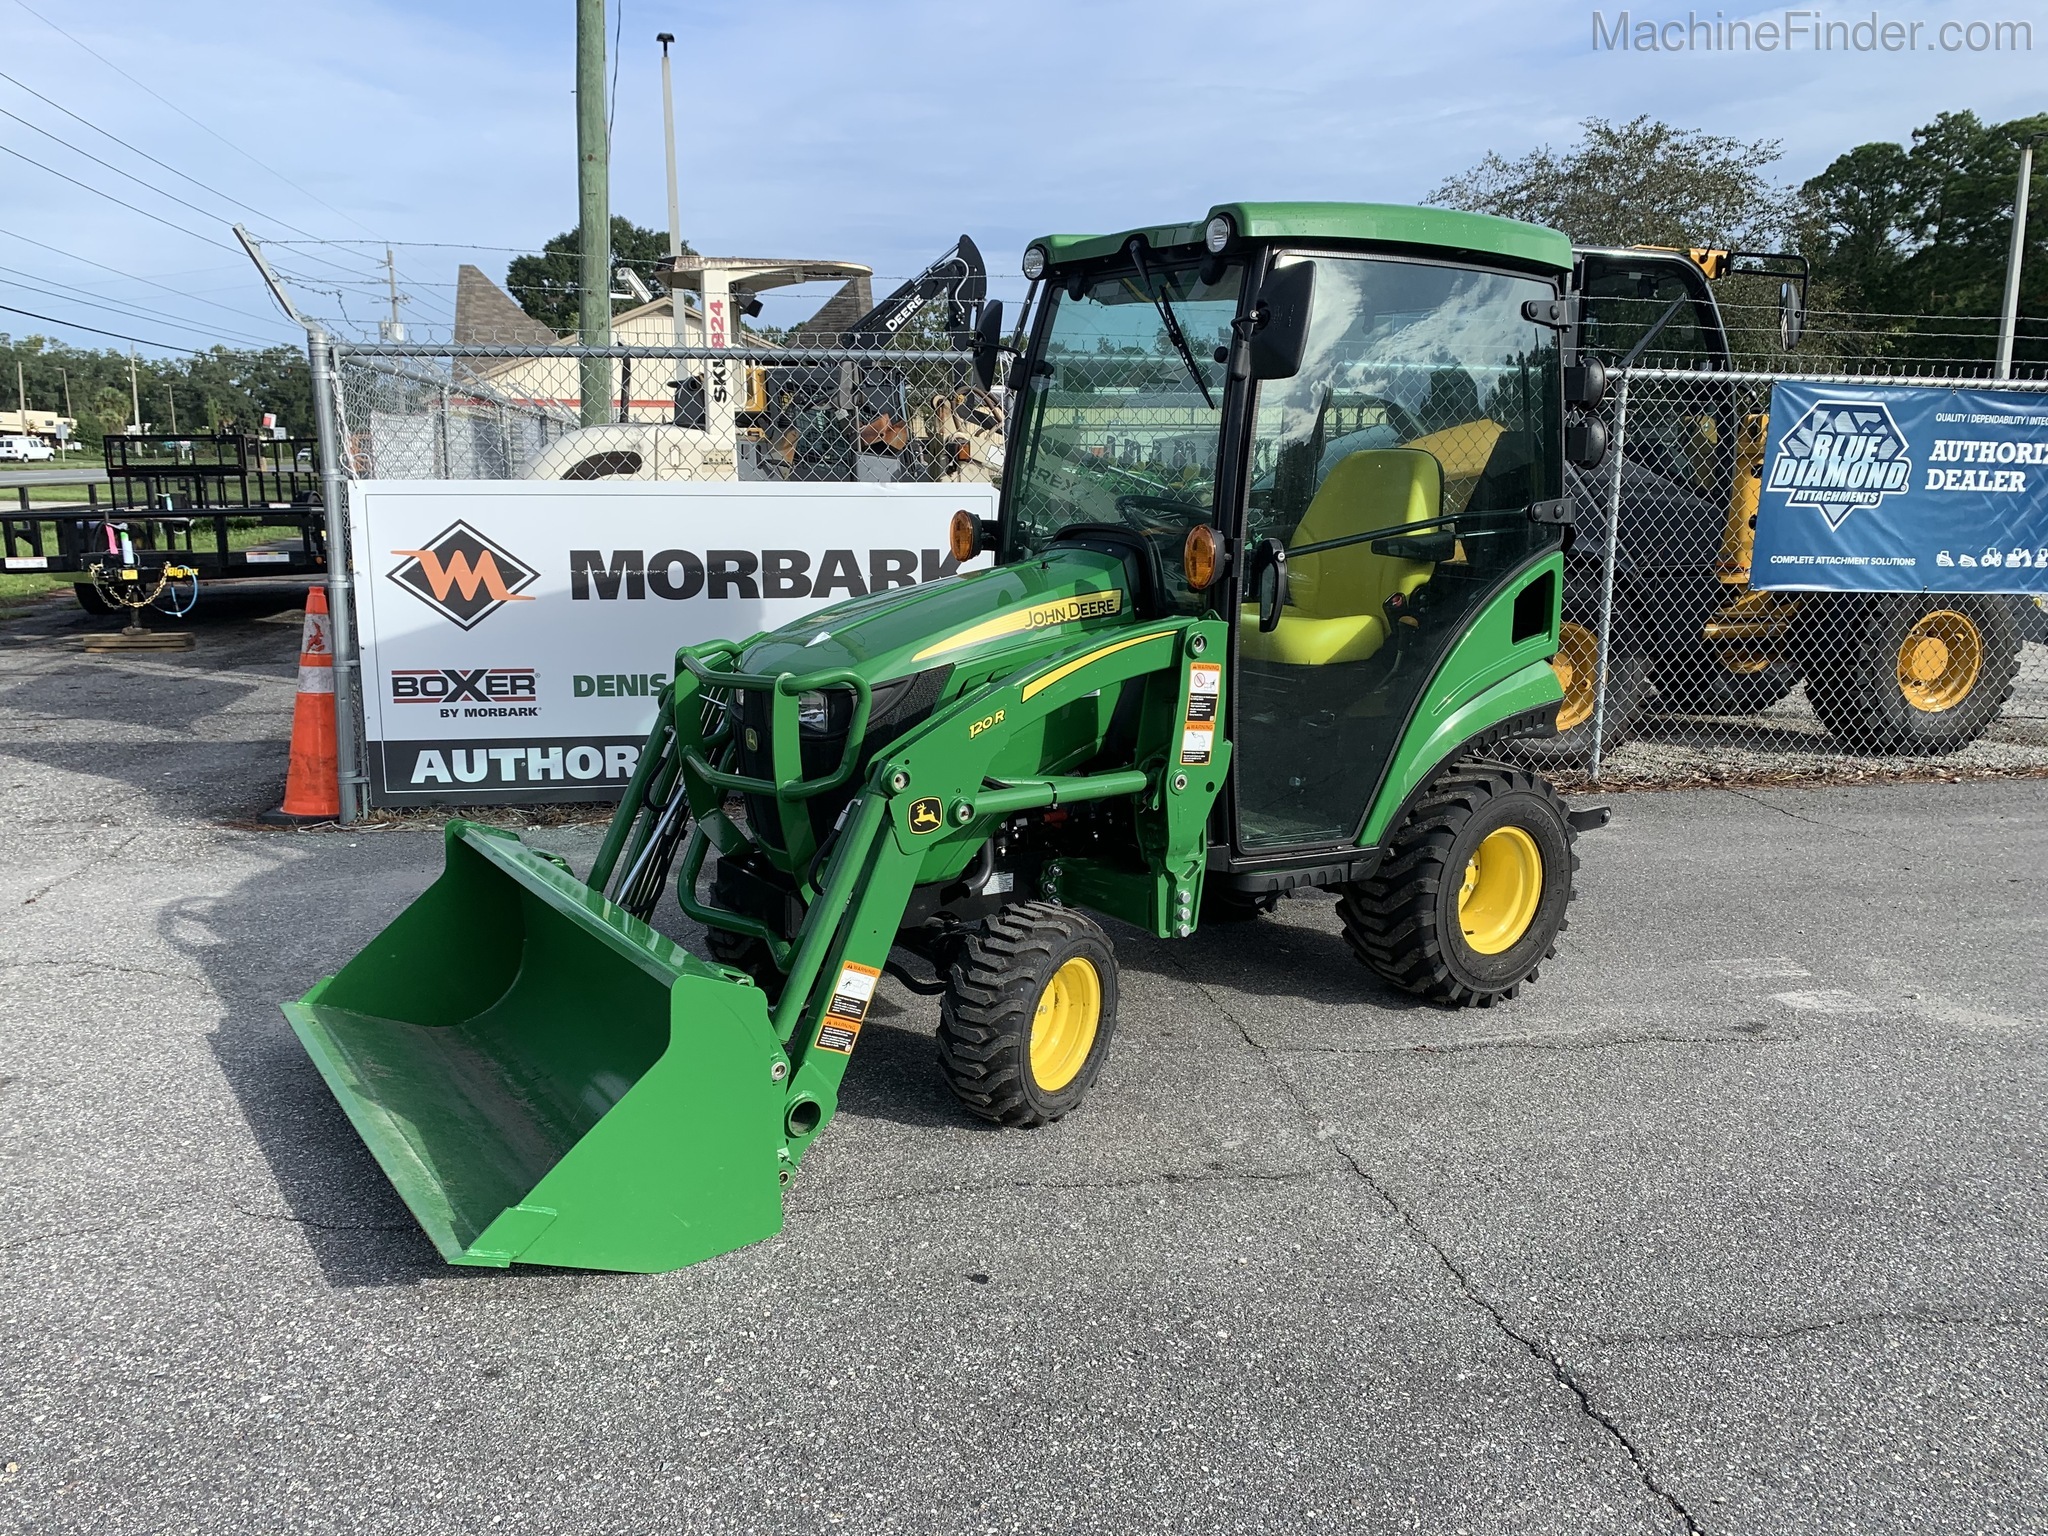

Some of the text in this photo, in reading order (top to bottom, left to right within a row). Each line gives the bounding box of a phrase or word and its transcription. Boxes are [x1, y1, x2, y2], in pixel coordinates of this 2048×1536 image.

[710, 300, 725, 349] 824
[885, 294, 924, 332] DEERE
[1935, 413, 1967, 422] QUALITY
[1971, 414, 2026, 425] DEPENDABILITY
[1809, 434, 1882, 463] BLUE
[1773, 458, 1907, 489] DIAMOND
[1924, 468, 2026, 492] DEALER
[1794, 490, 1879, 503] ATTACHMENTS
[1770, 555, 1916, 566] COMPLETE ATTACHMENT SOLUTIONS
[1025, 599, 1115, 628] JOHN DEERE
[392, 669, 536, 702] BOXER
[573, 673, 667, 698] DENIS
[440, 707, 538, 718] BY MORBARK
[969, 709, 1005, 739] 120 R
[410, 745, 646, 784] AUTHOR
